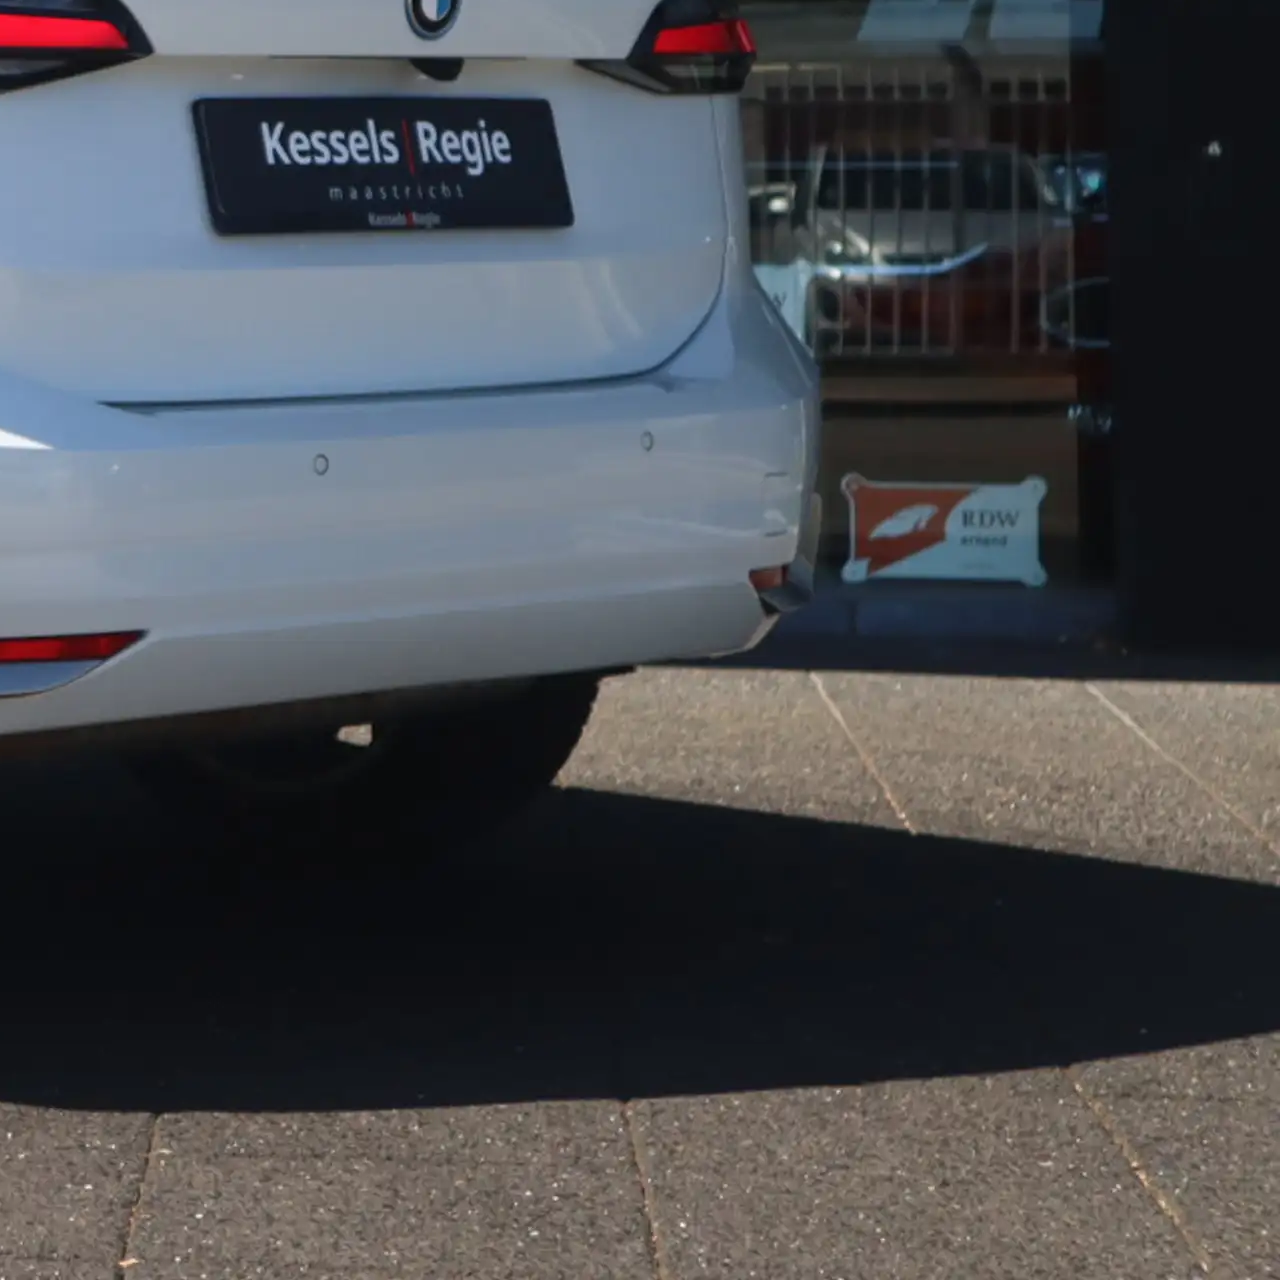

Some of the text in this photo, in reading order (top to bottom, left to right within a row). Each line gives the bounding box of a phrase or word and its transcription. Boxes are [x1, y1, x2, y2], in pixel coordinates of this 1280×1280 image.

[260, 118, 512, 176] Kessels Regie
[329, 180, 465, 201] maastricht
[960, 509, 1020, 529] RDW
